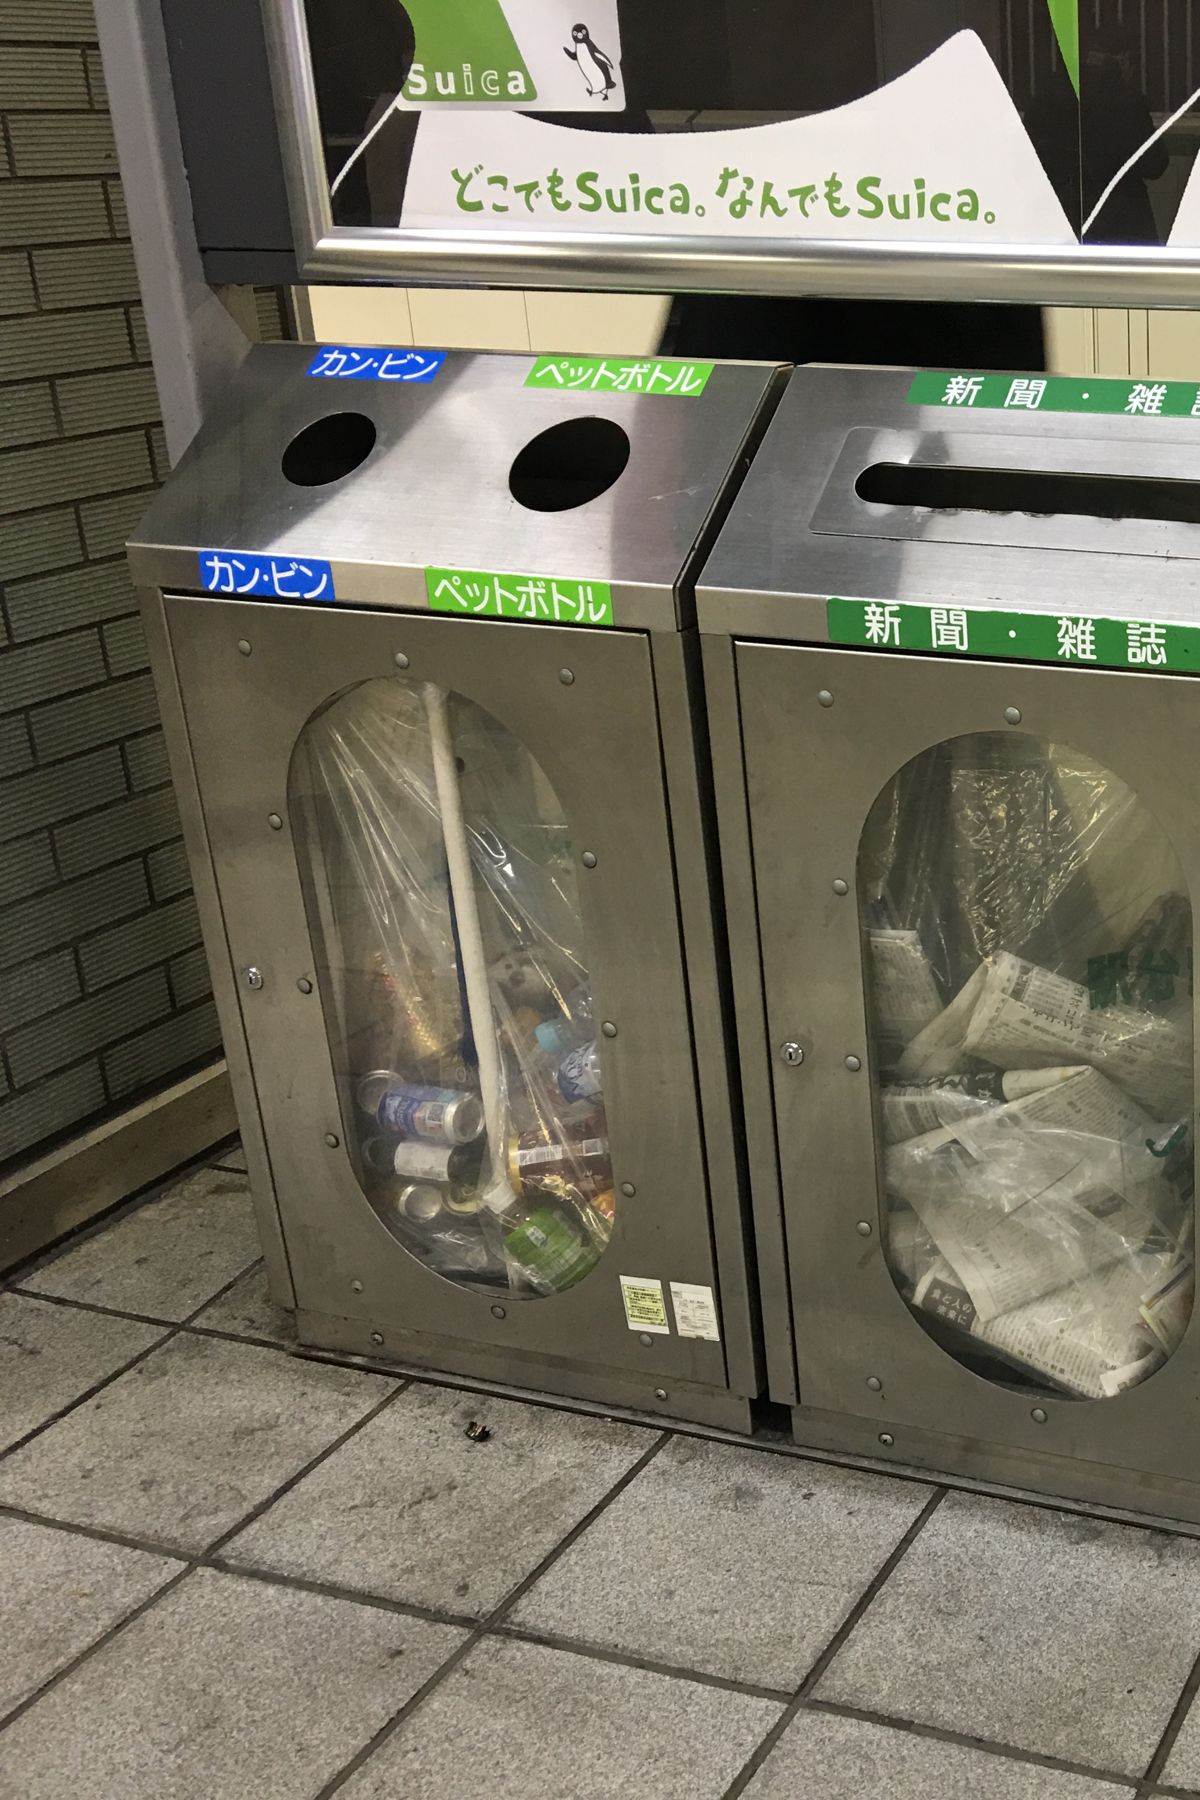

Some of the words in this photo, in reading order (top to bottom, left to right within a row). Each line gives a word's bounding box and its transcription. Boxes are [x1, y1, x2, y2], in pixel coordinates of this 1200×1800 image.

[407, 64, 527, 97] Suica
[311, 350, 438, 381] カン・ビン
[535, 361, 702, 393] ペットボトル
[205, 556, 328, 601] カン・ビン
[434, 576, 607, 623] ペットボトル
[863, 603, 1168, 666] 新聞・雑誌
